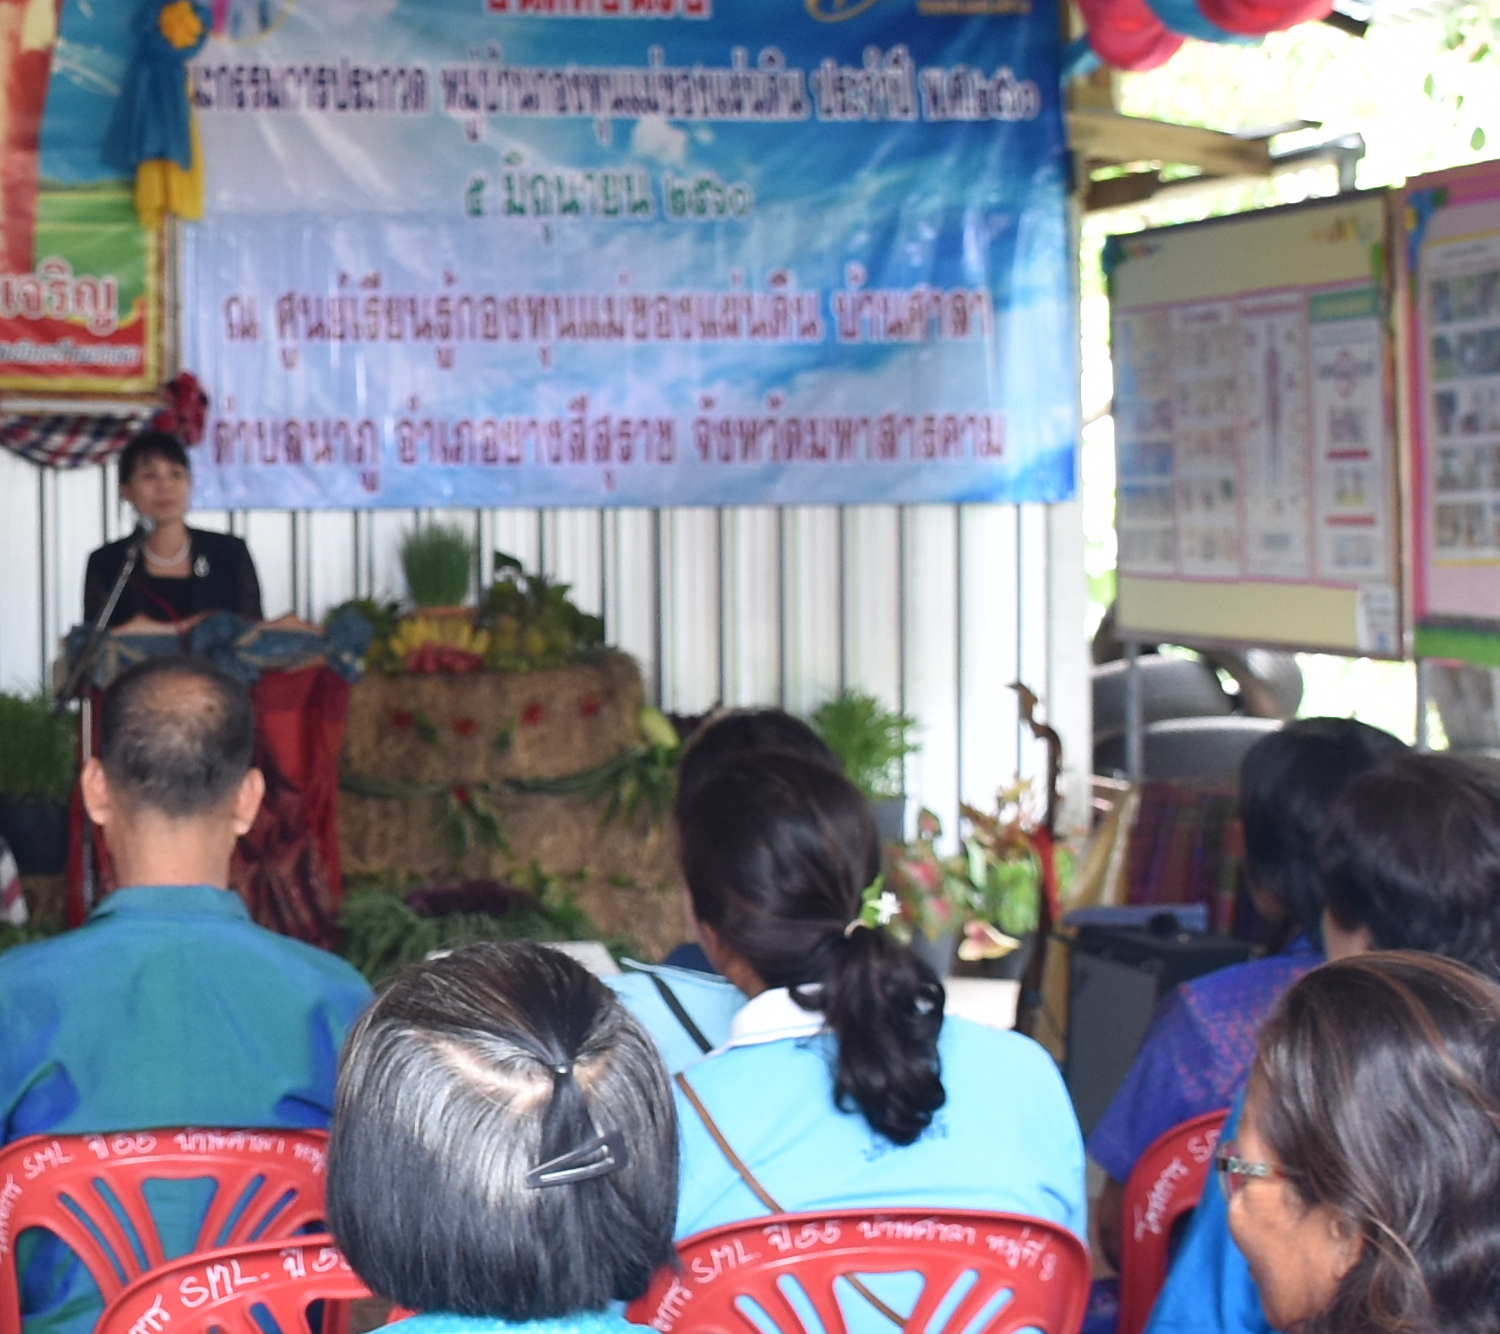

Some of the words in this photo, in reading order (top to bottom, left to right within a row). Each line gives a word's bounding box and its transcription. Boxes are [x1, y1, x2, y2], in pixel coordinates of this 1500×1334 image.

[502, 149, 654, 245] มิถุนายน
[832, 264, 994, 341] บ้านศาลา
[212, 393, 381, 495] ตำบลนาภู
[395, 393, 675, 493] อำเภอยางสีสุราช
[692, 393, 1007, 464] จังหวัดมหาสารคาม
